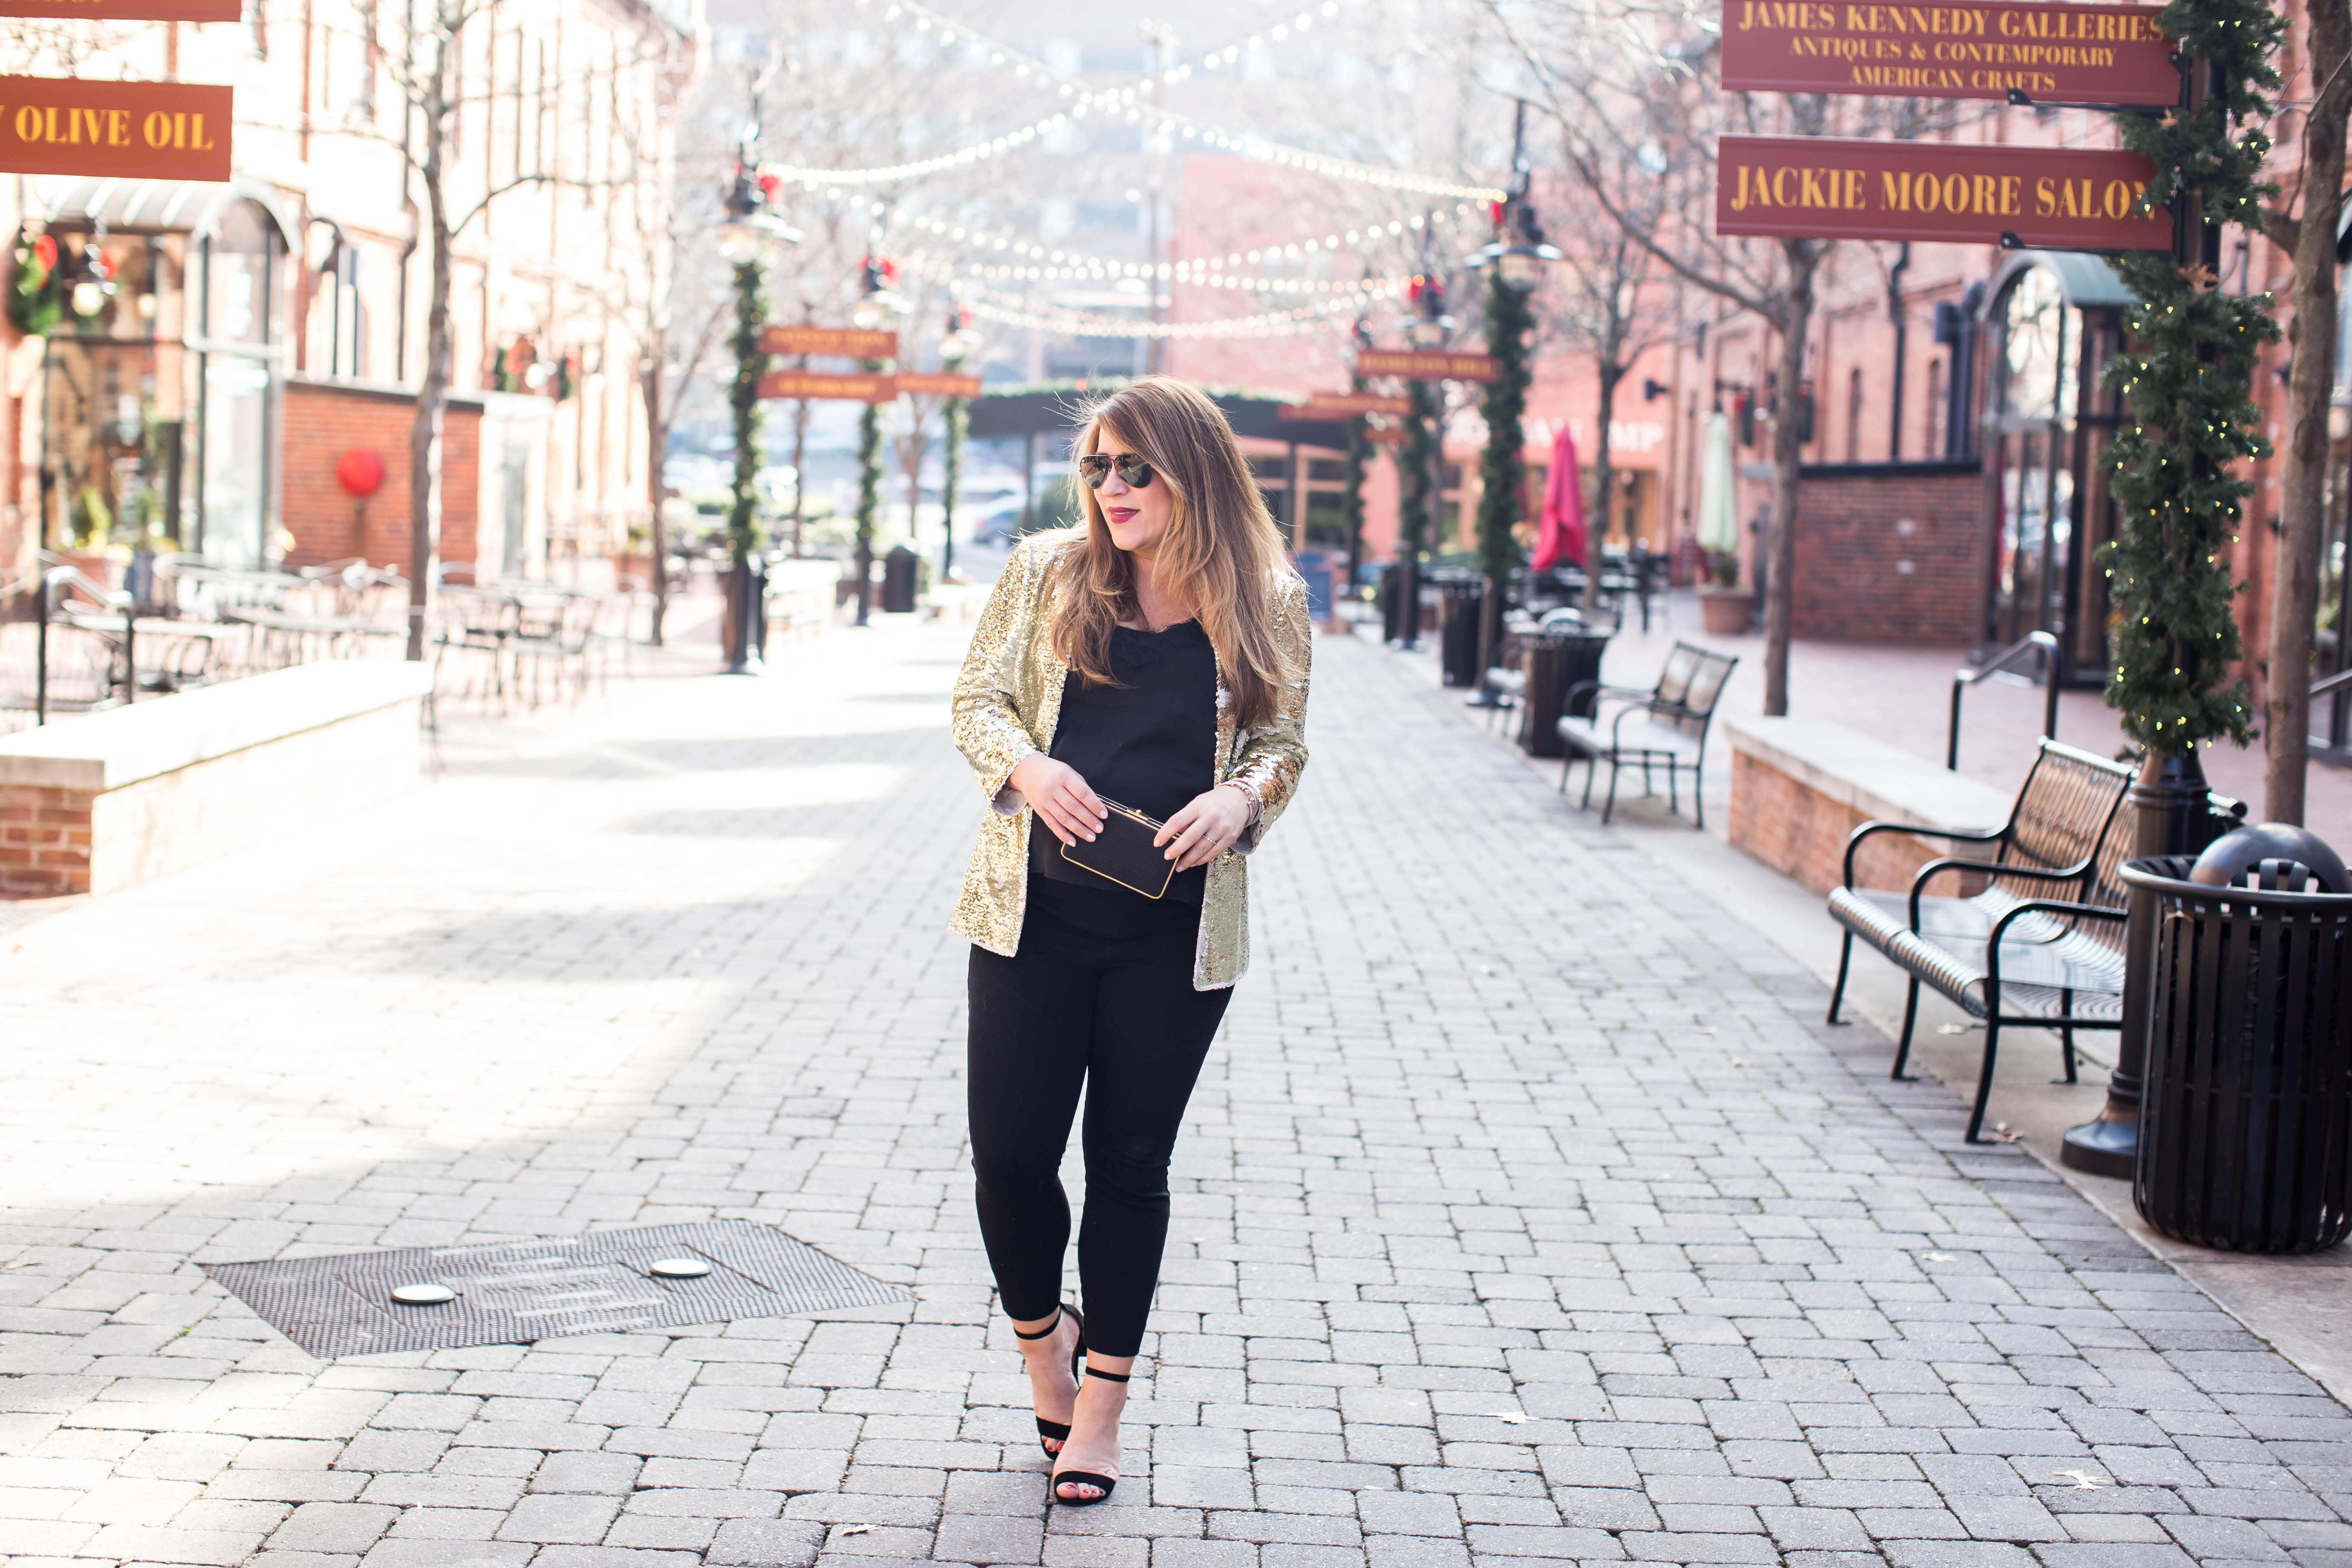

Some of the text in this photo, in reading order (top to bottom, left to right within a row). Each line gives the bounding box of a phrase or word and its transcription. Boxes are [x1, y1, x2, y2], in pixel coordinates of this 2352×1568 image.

[1738, 0, 2165, 42] JAMES KENNEDY GALLERIES
[1788, 36, 2116, 67] ANTIQUES & CONTEMPORARY
[1850, 65, 2056, 92] AMERICAN CRAFTS
[15, 105, 131, 146] OLIVE
[143, 110, 214, 150] OIL
[1730, 165, 1866, 212] JACKIE
[1880, 170, 2021, 215] MOORE
